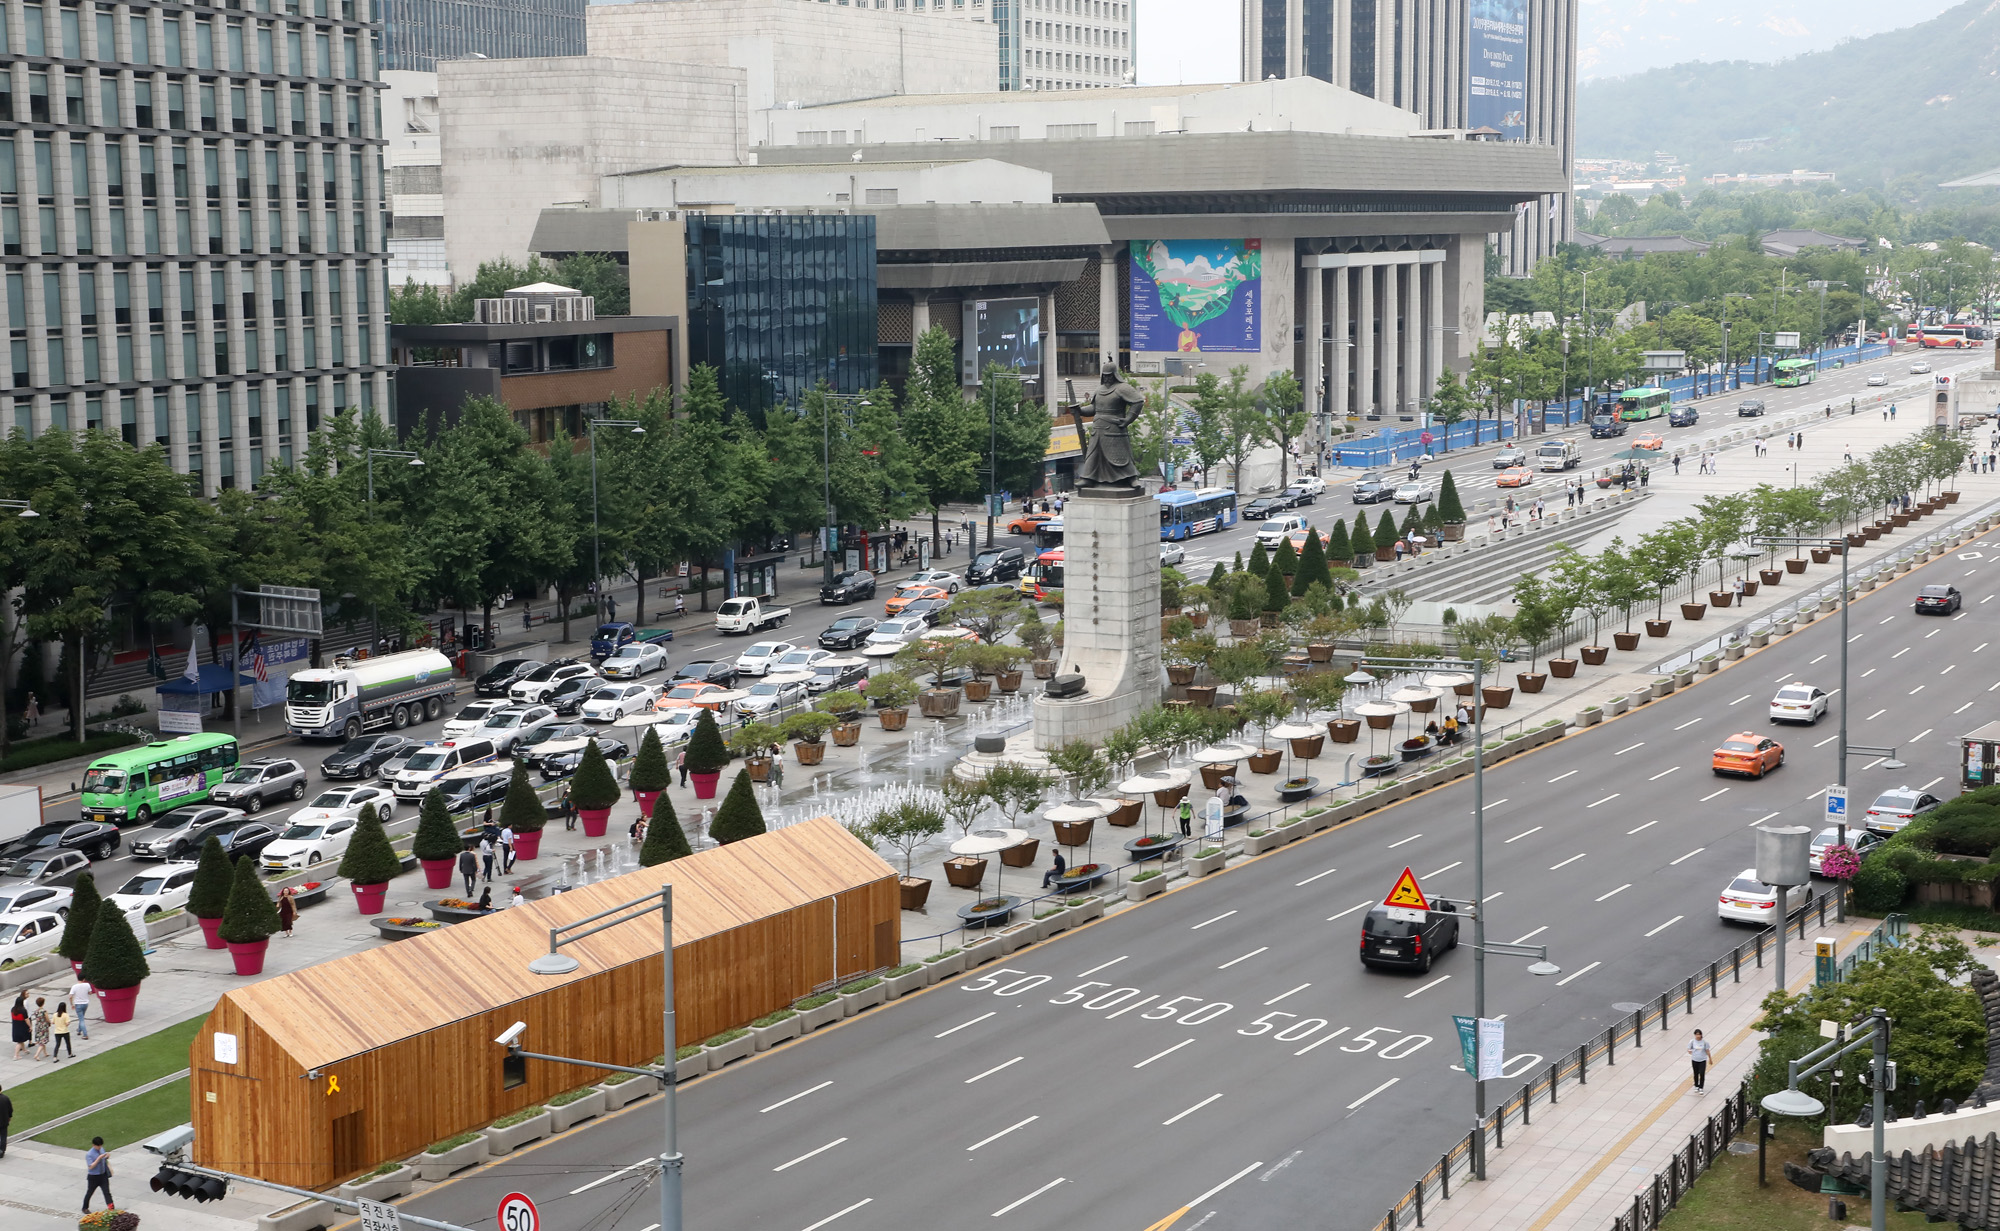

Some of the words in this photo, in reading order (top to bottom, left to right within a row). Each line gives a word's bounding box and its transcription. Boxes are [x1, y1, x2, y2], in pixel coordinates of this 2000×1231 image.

[961, 969, 1052, 997] 50
[1049, 981, 1139, 1010] 50
[1141, 995, 1233, 1026] 50
[1237, 1011, 1328, 1042] 50
[1340, 1026, 1433, 1060] 50
[507, 1206, 531, 1231] 50
